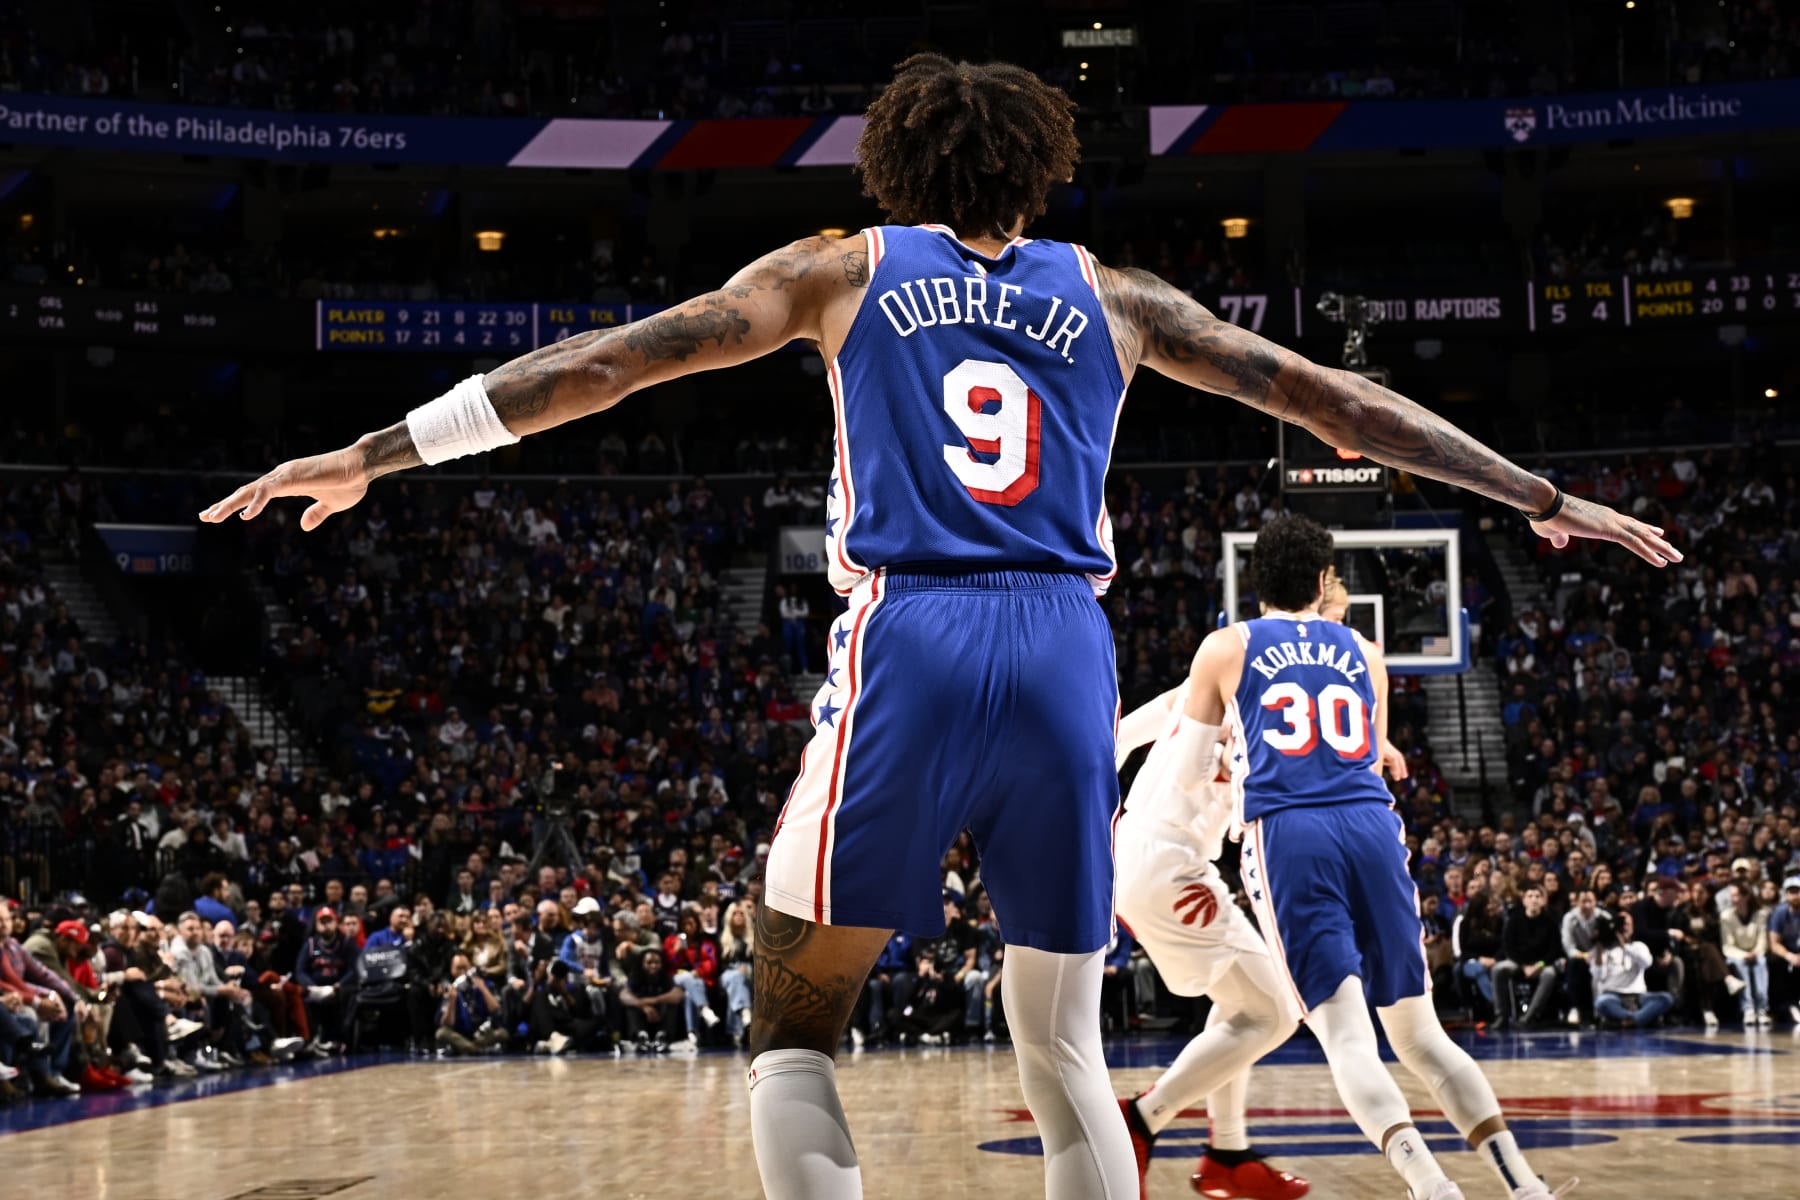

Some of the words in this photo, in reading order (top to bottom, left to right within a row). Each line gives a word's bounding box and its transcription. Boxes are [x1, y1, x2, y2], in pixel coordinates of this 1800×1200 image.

[1546, 102, 1612, 130] Penn
[1616, 93, 1742, 124] Medicine
[94, 112, 122, 134] of
[127, 114, 169, 138] the
[176, 117, 332, 151] Philadelphia
[338, 126, 407, 149] 76ers
[1544, 284, 1571, 300] FLS
[1584, 281, 1613, 298] TOL
[1635, 279, 1694, 298] PLAYER
[1706, 278, 1718, 293] 4
[1766, 274, 1774, 289] 1
[550, 309, 575, 324] FLS
[589, 309, 615, 324] TOL
[1219, 295, 1268, 333] 77
[1414, 297, 1501, 320] RAPTORS
[1551, 302, 1567, 324] 5
[1592, 300, 1608, 321] 4
[1636, 299, 1695, 318] POINTS
[1702, 298, 1724, 314] 20
[1763, 294, 1776, 310] 0
[38, 315, 65, 328] UTA
[329, 309, 385, 324] PLAYER
[398, 309, 409, 324] 9
[422, 310, 440, 325] 21
[478, 310, 497, 326] 22
[505, 310, 526, 326] 30
[878, 276, 1023, 337] OUBRE
[1025, 296, 1089, 365] JR.
[329, 329, 385, 343] POINTS
[395, 329, 411, 344] 17
[422, 330, 440, 345] 21
[455, 330, 466, 344] 4
[481, 330, 493, 345] 2
[510, 330, 521, 345] 5
[944, 358, 1041, 507] 9
[1313, 467, 1382, 483] TISSOT
[786, 552, 818, 570] 108
[1250, 641, 1366, 683] KORKMAZ
[1260, 682, 1370, 759] 30
